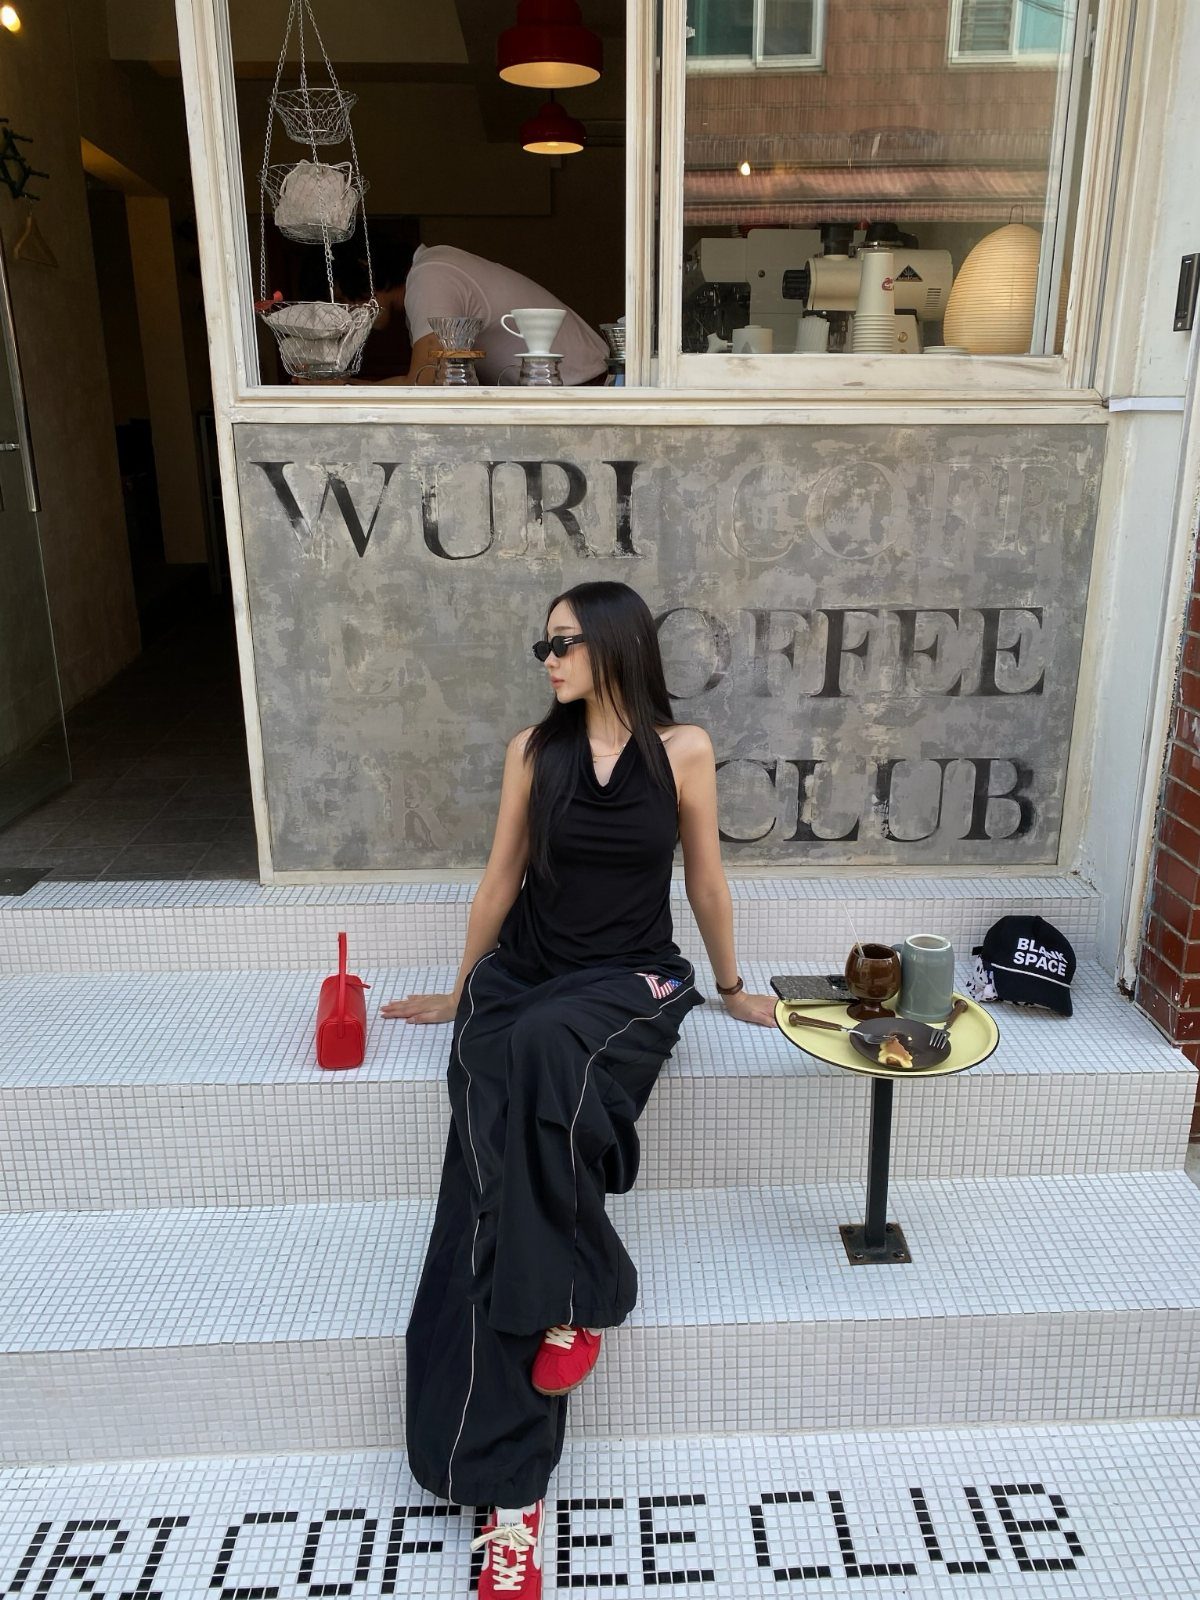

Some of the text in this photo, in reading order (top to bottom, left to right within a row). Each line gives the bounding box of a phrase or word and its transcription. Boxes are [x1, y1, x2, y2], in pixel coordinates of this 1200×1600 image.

[250, 460, 645, 561] WURI
[1013, 951, 1067, 976] SPACE
[1016, 937, 1068, 964] BLANK
[750, 1483, 1086, 1582] CLUB
